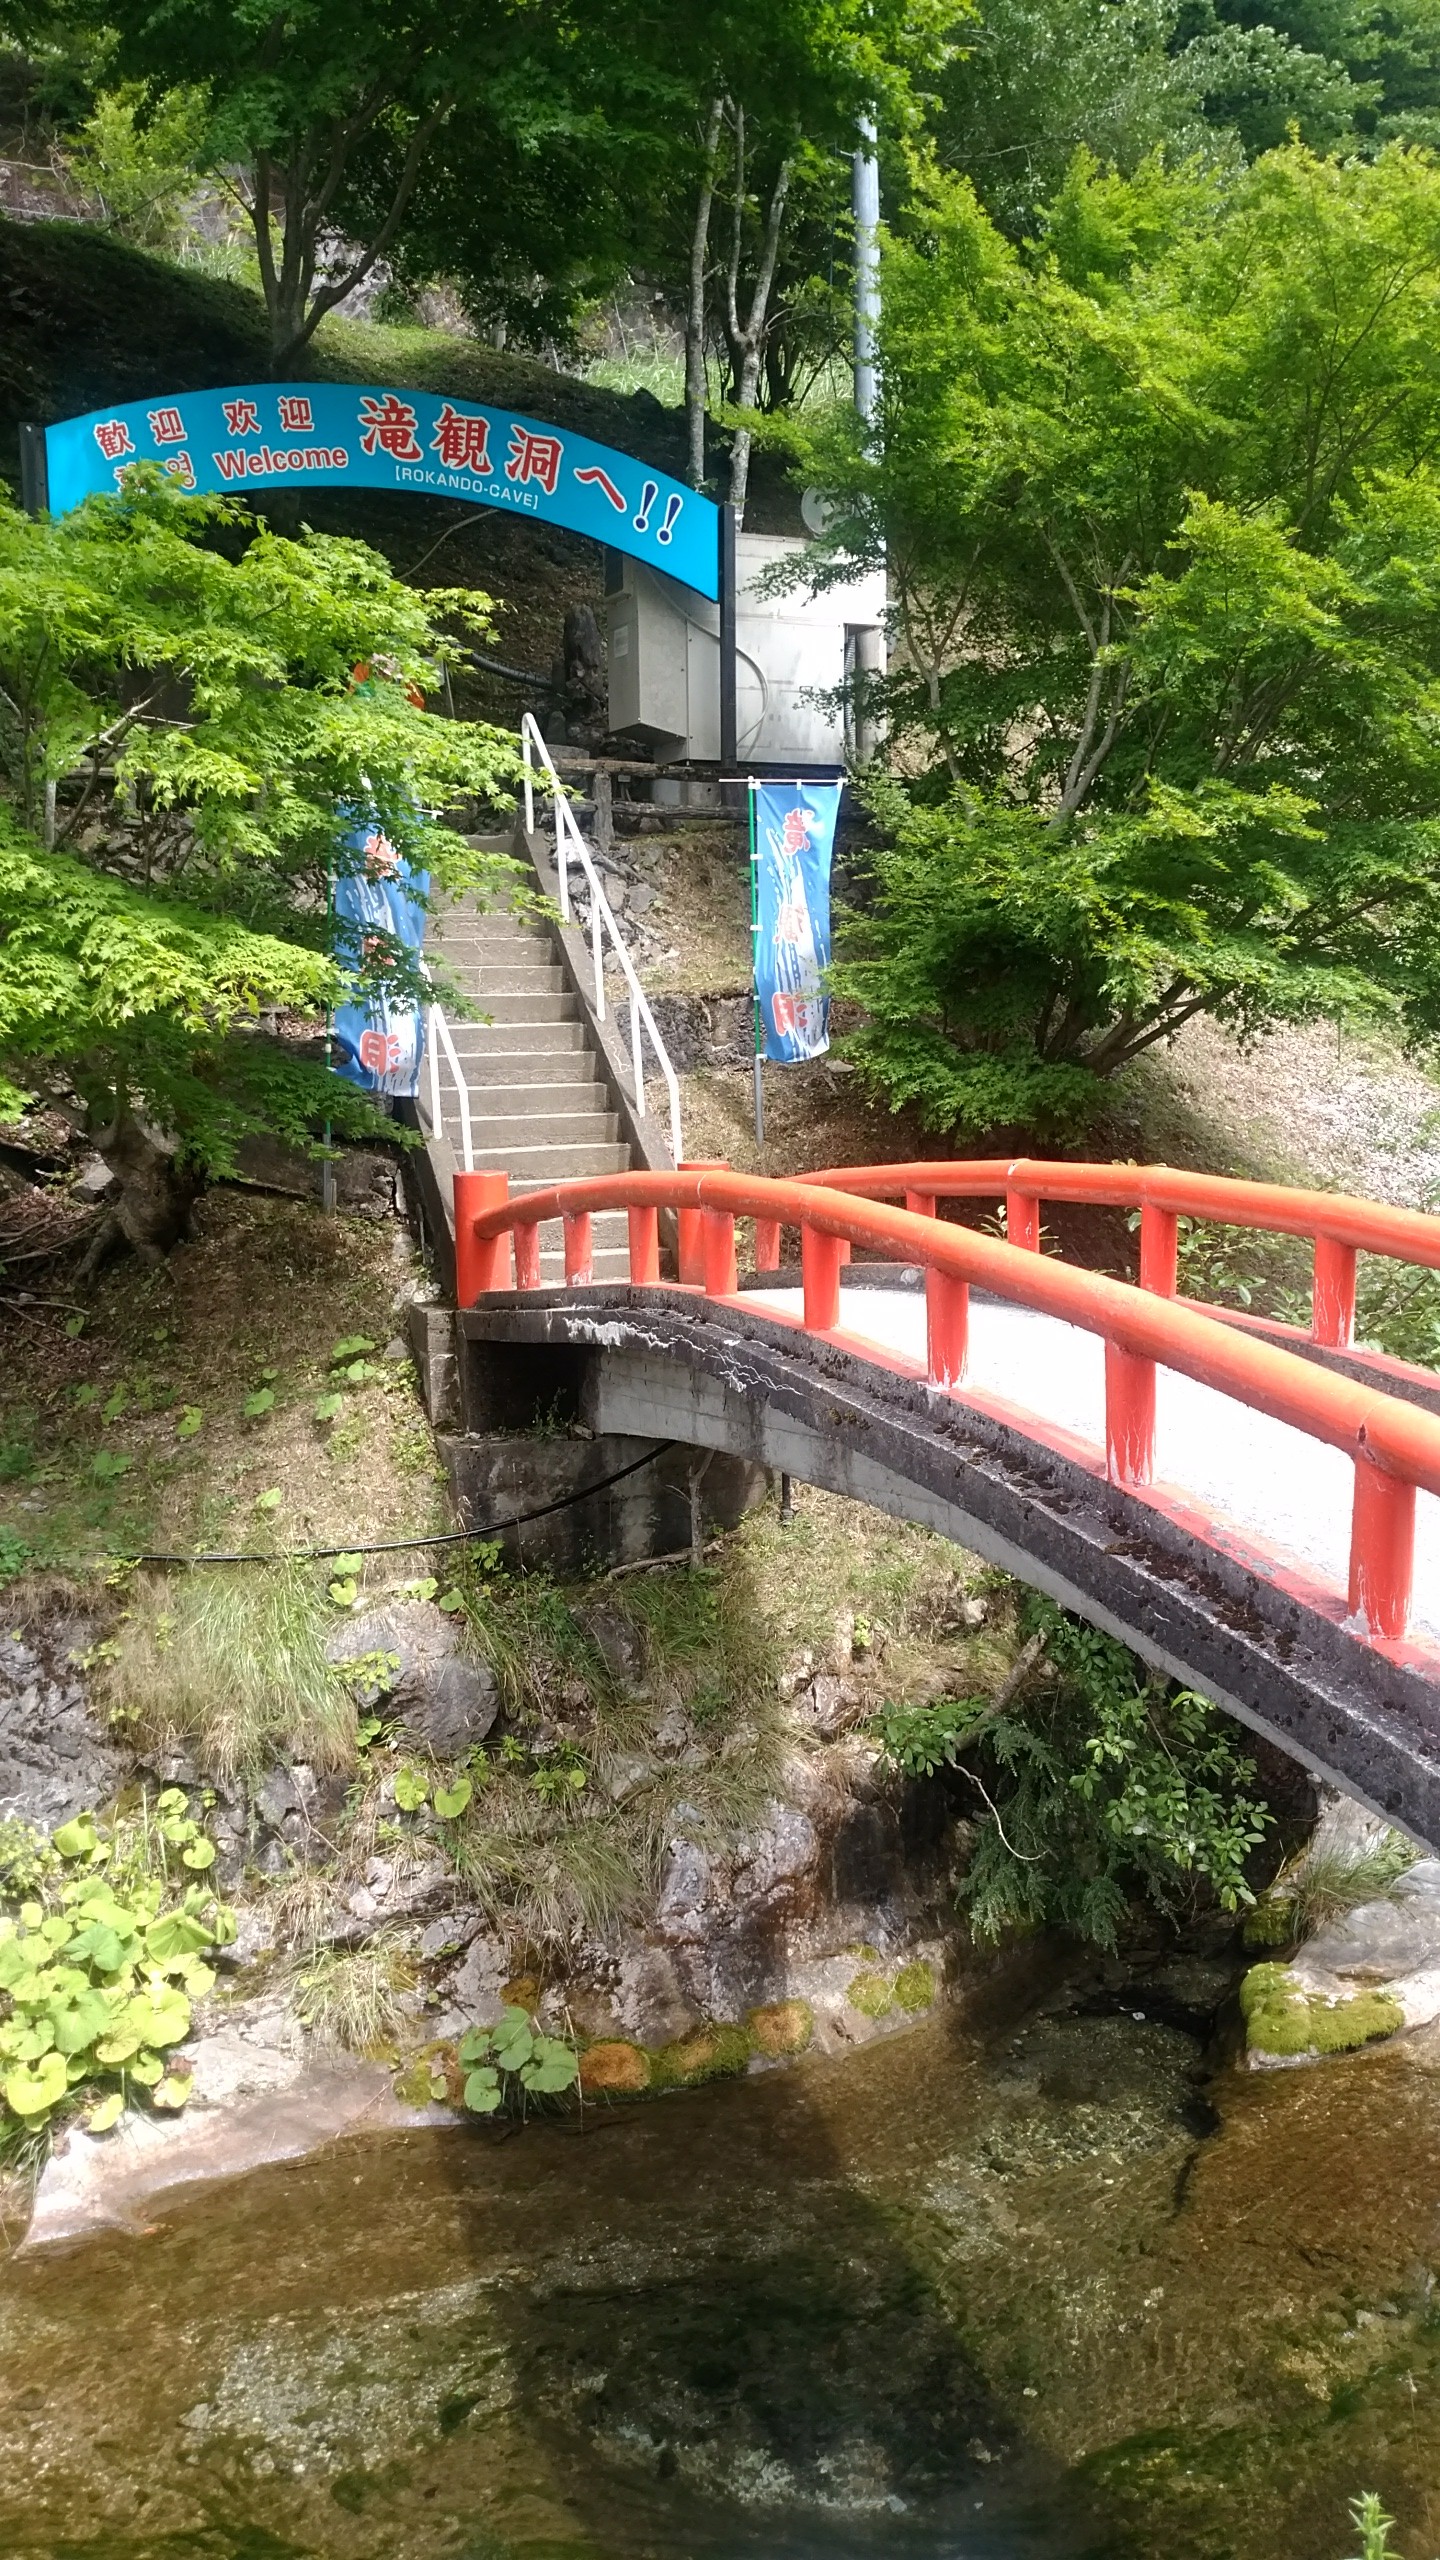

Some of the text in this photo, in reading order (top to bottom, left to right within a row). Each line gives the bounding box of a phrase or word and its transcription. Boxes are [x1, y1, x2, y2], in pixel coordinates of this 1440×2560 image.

[222, 396, 313, 436] 欢迎
[113, 451, 198, 492] 영
[212, 445, 349, 480] Welcome
